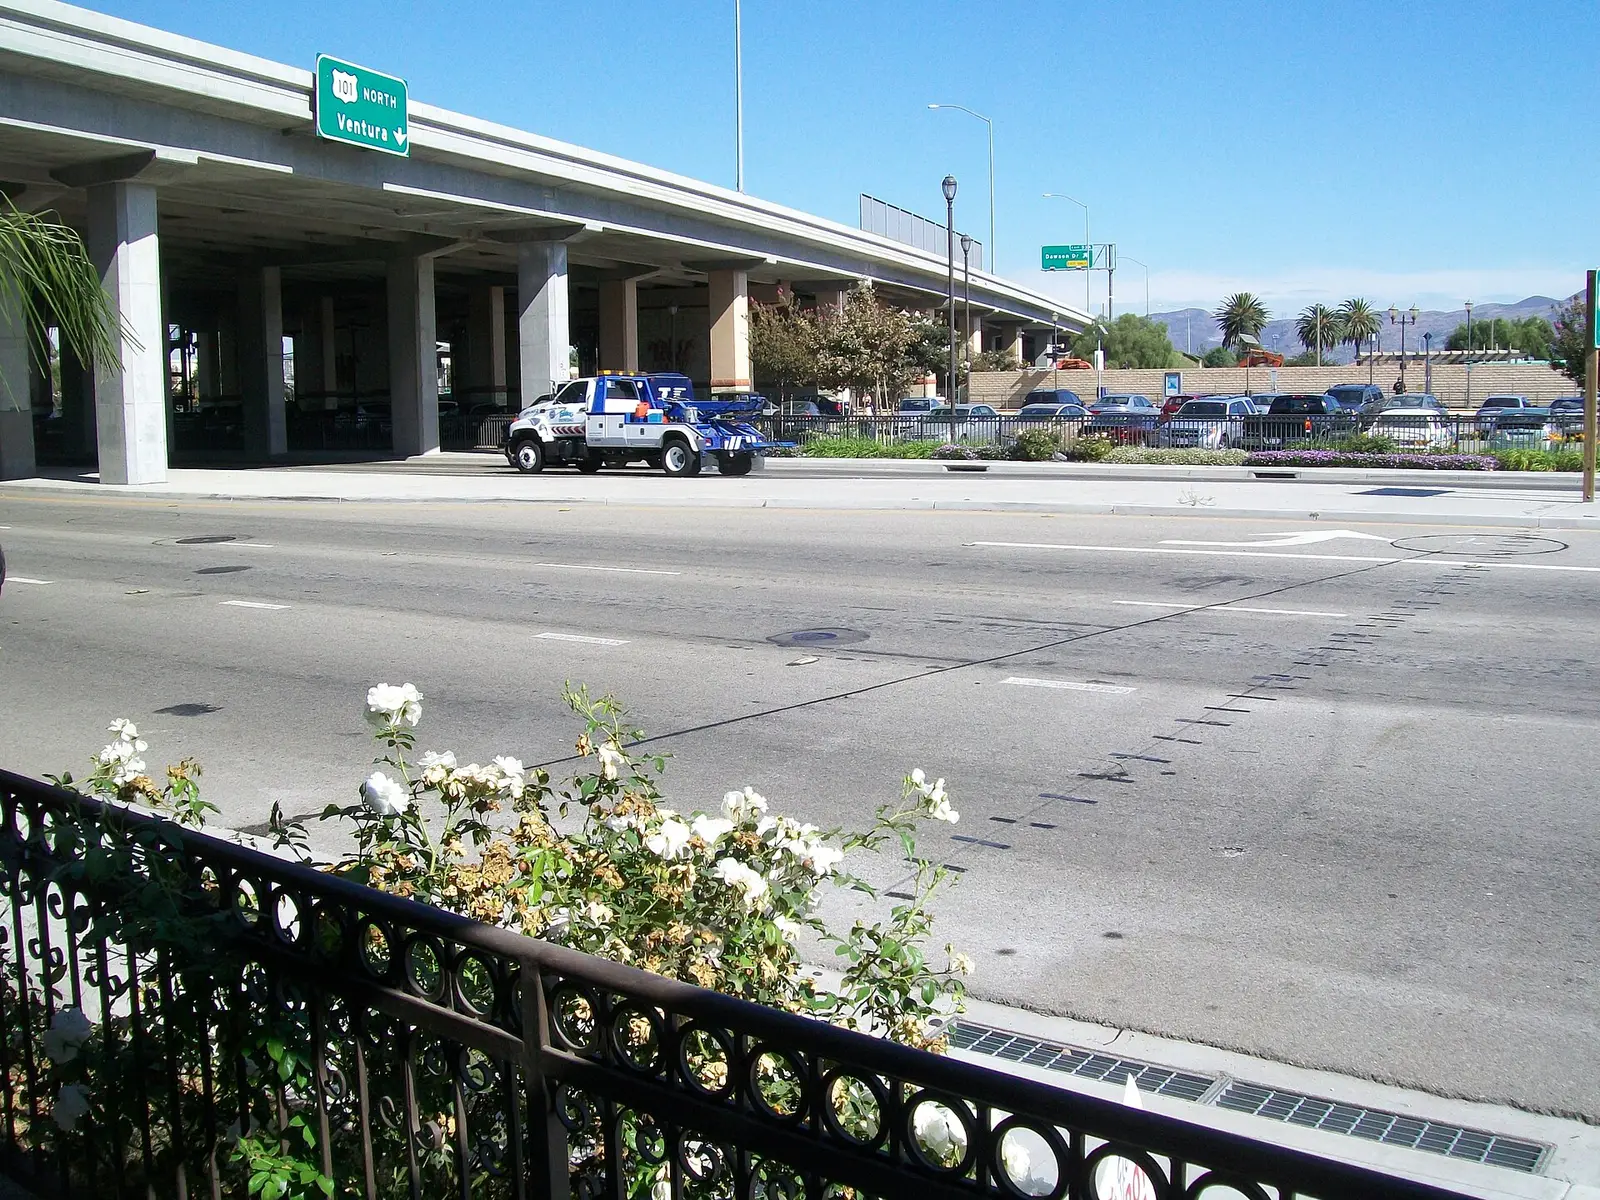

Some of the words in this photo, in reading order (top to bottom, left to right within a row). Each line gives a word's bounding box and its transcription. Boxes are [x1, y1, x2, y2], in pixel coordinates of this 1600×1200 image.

[338, 79, 353, 96] 101
[363, 87, 397, 108] NORTH
[337, 112, 388, 141] Ventura
